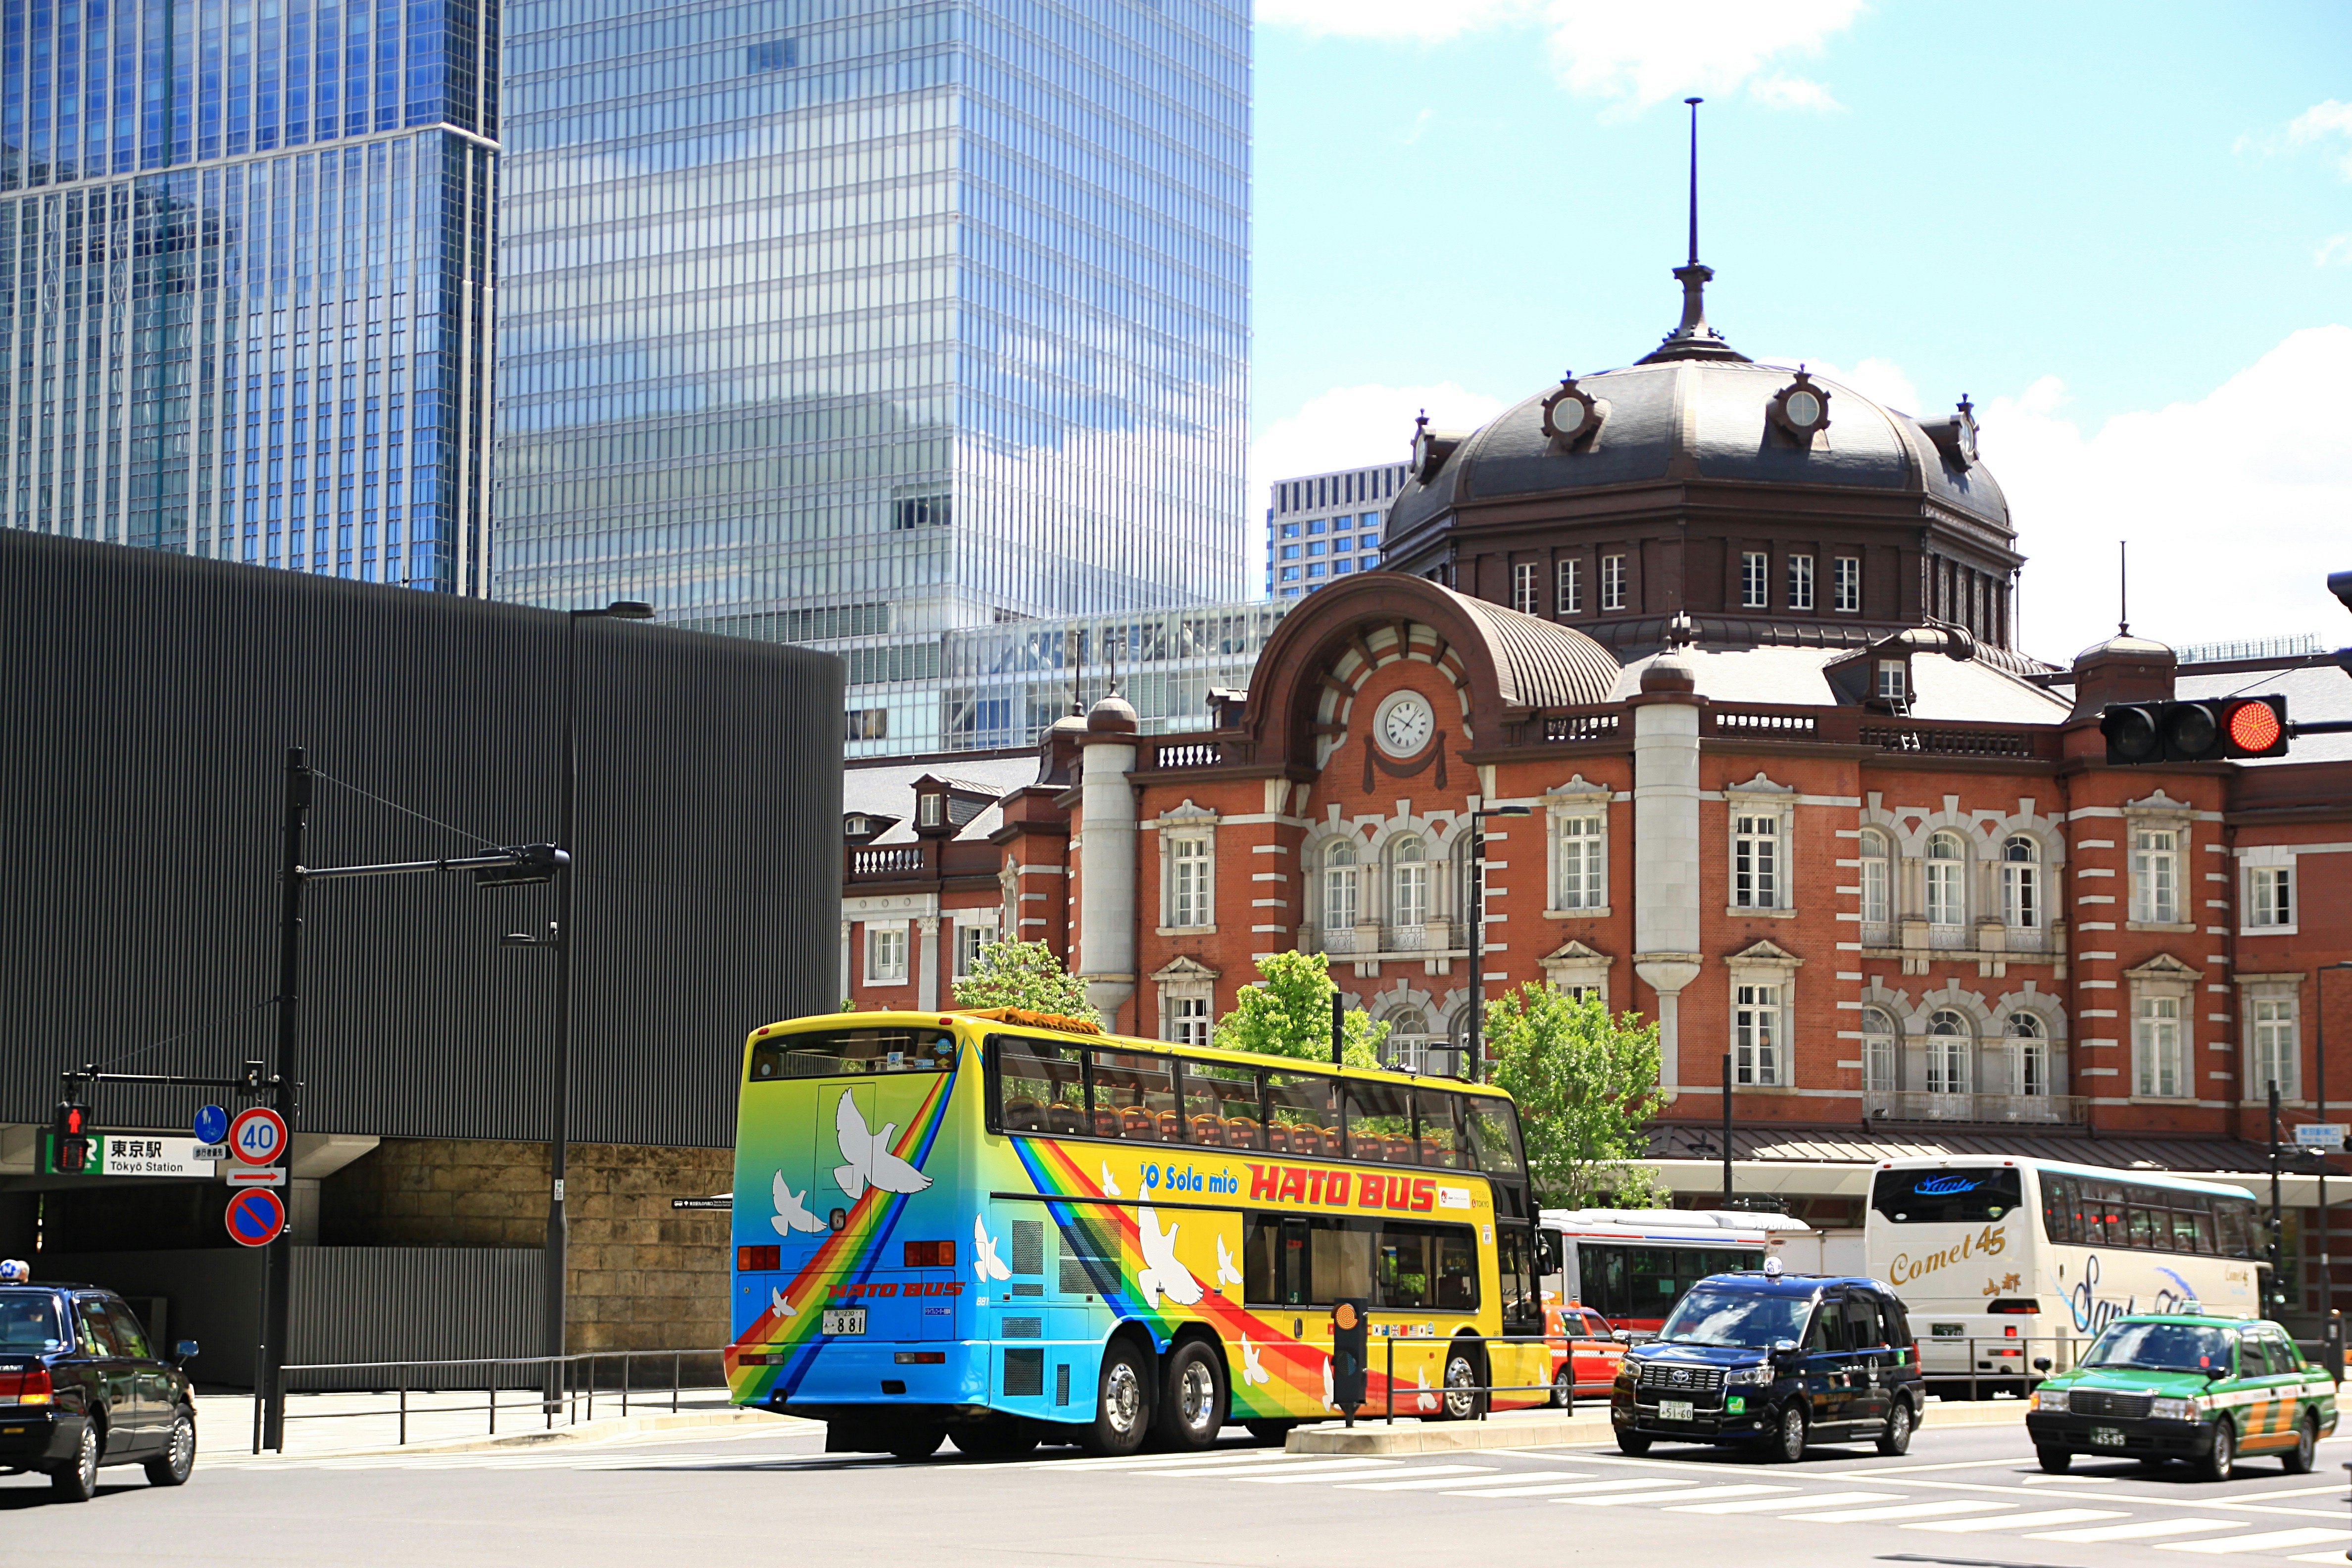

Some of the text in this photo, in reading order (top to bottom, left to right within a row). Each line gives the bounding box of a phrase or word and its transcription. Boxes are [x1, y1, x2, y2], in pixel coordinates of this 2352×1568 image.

[242, 1124, 273, 1149] 40
[111, 1140, 162, 1158] 東京駅
[196, 1148, 223, 1157] 歩行者優先
[110, 1161, 183, 1174] Tōkyō Station
[1165, 1163, 1204, 1191] Sola
[1208, 1166, 1239, 1194] mio
[1243, 1163, 1437, 1212] HATO BUS
[1890, 1225, 2006, 1285] Comet 45
[825, 1281, 966, 1298] HATO BUS
[1983, 1272, 2021, 1296] 山都
[976, 1297, 989, 1306] 881
[1667, 1408, 1691, 1418] 51-60
